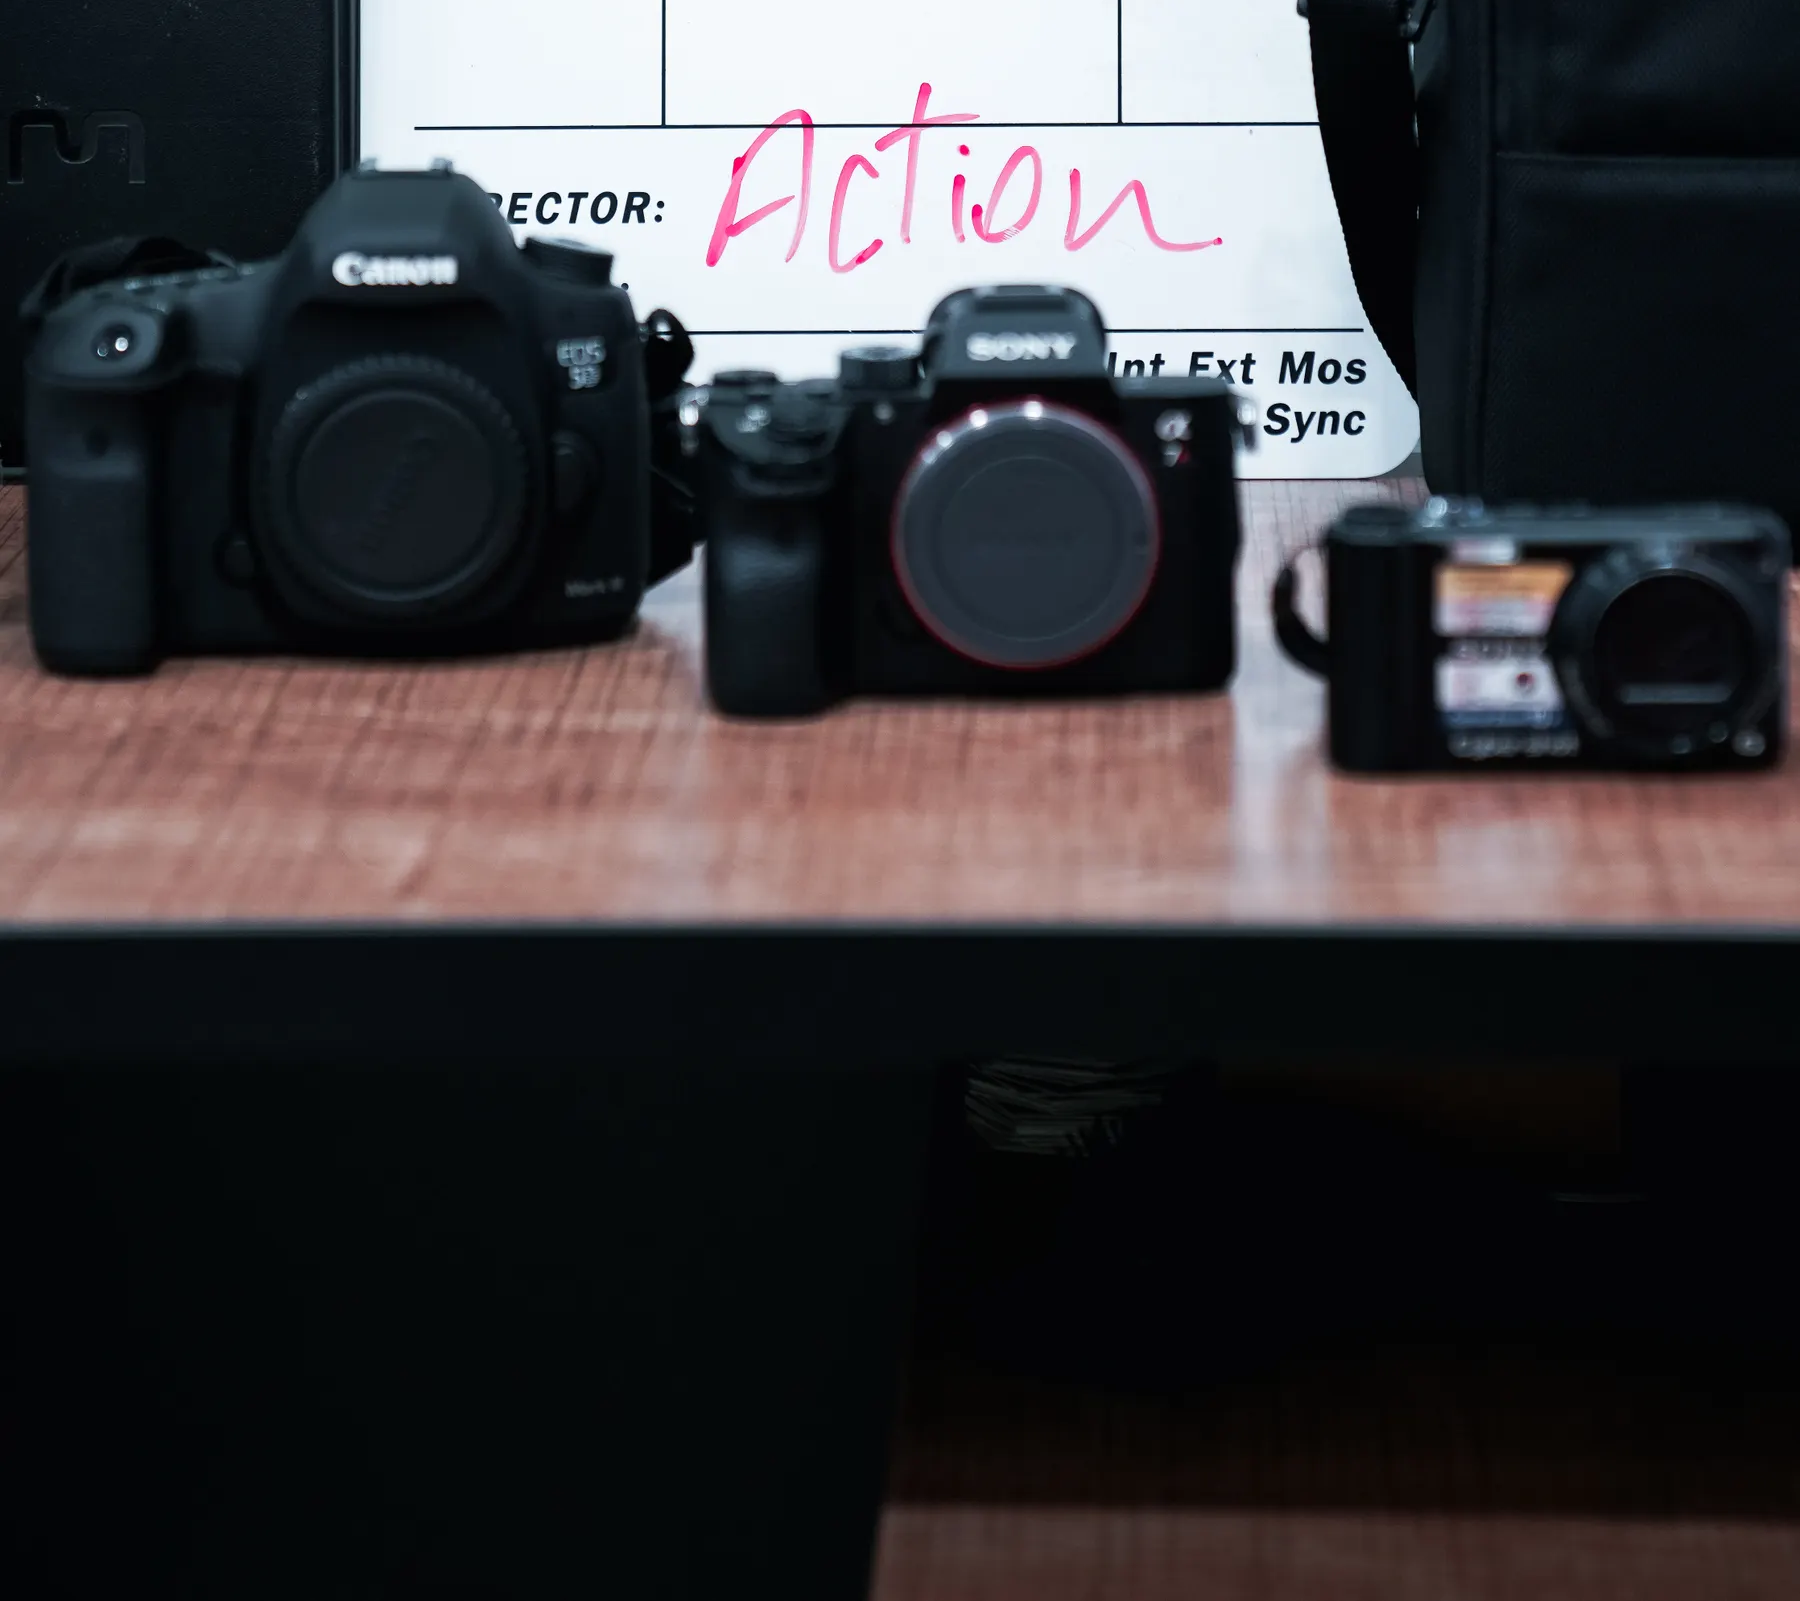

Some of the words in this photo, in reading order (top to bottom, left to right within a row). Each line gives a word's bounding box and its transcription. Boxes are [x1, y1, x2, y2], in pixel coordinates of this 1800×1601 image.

[705, 81, 1223, 273] Action
[331, 251, 459, 288] Canon
[965, 331, 1079, 363] SONY
[1105, 351, 1166, 378] Int
[1188, 351, 1257, 385] Ext
[1278, 350, 1367, 385] Mos
[1262, 402, 1366, 444] Sync
